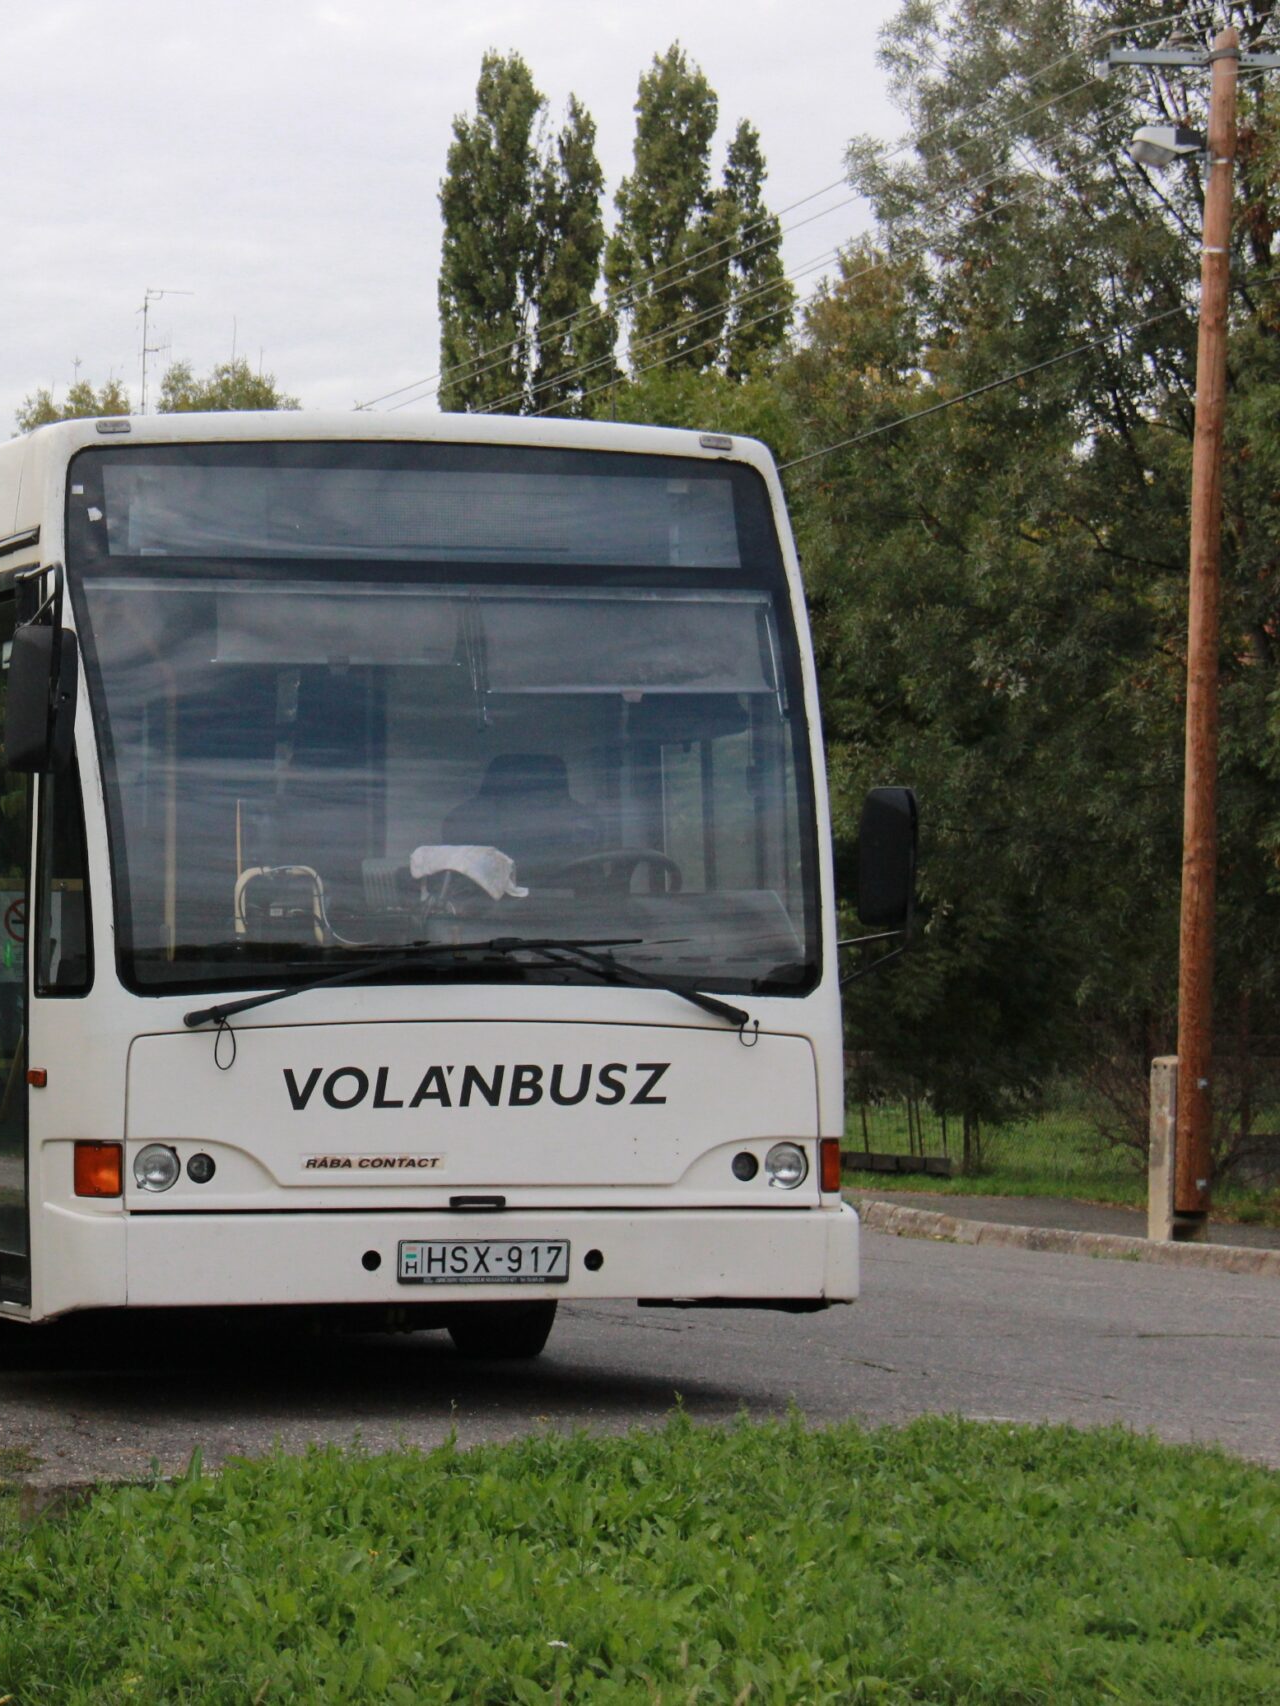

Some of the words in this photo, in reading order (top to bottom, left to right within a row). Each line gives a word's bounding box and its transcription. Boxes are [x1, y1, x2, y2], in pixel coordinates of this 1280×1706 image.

[282, 1062, 672, 1111] VOLÁNBUSZ
[305, 1156, 353, 1169] RÁBA
[358, 1157, 440, 1169] CONTACT
[405, 1261, 418, 1274] H
[427, 1246, 563, 1274] HSX-917
